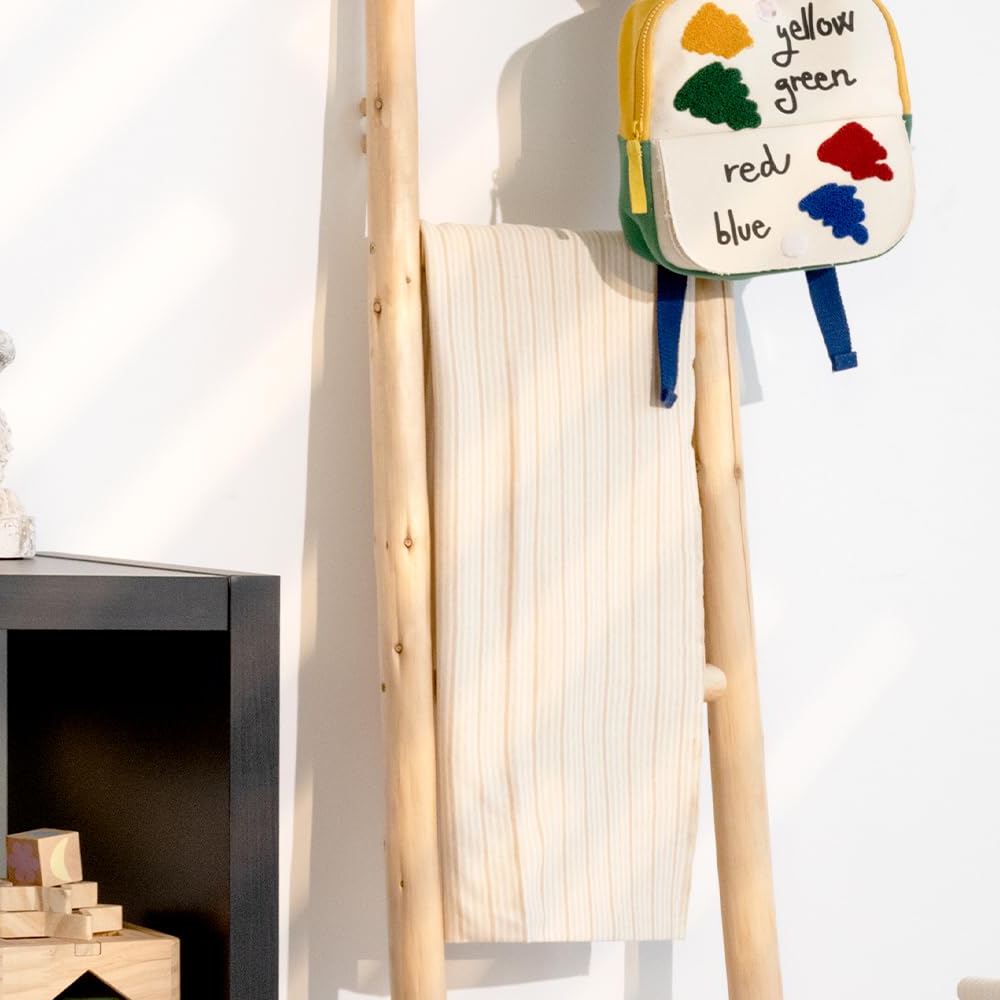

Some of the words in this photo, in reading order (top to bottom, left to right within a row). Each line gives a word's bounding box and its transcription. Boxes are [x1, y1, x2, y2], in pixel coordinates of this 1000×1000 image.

[772, 3, 854, 67] yellow
[775, 69, 857, 114] green
[724, 144, 791, 183] red
[714, 209, 771, 246] blue
